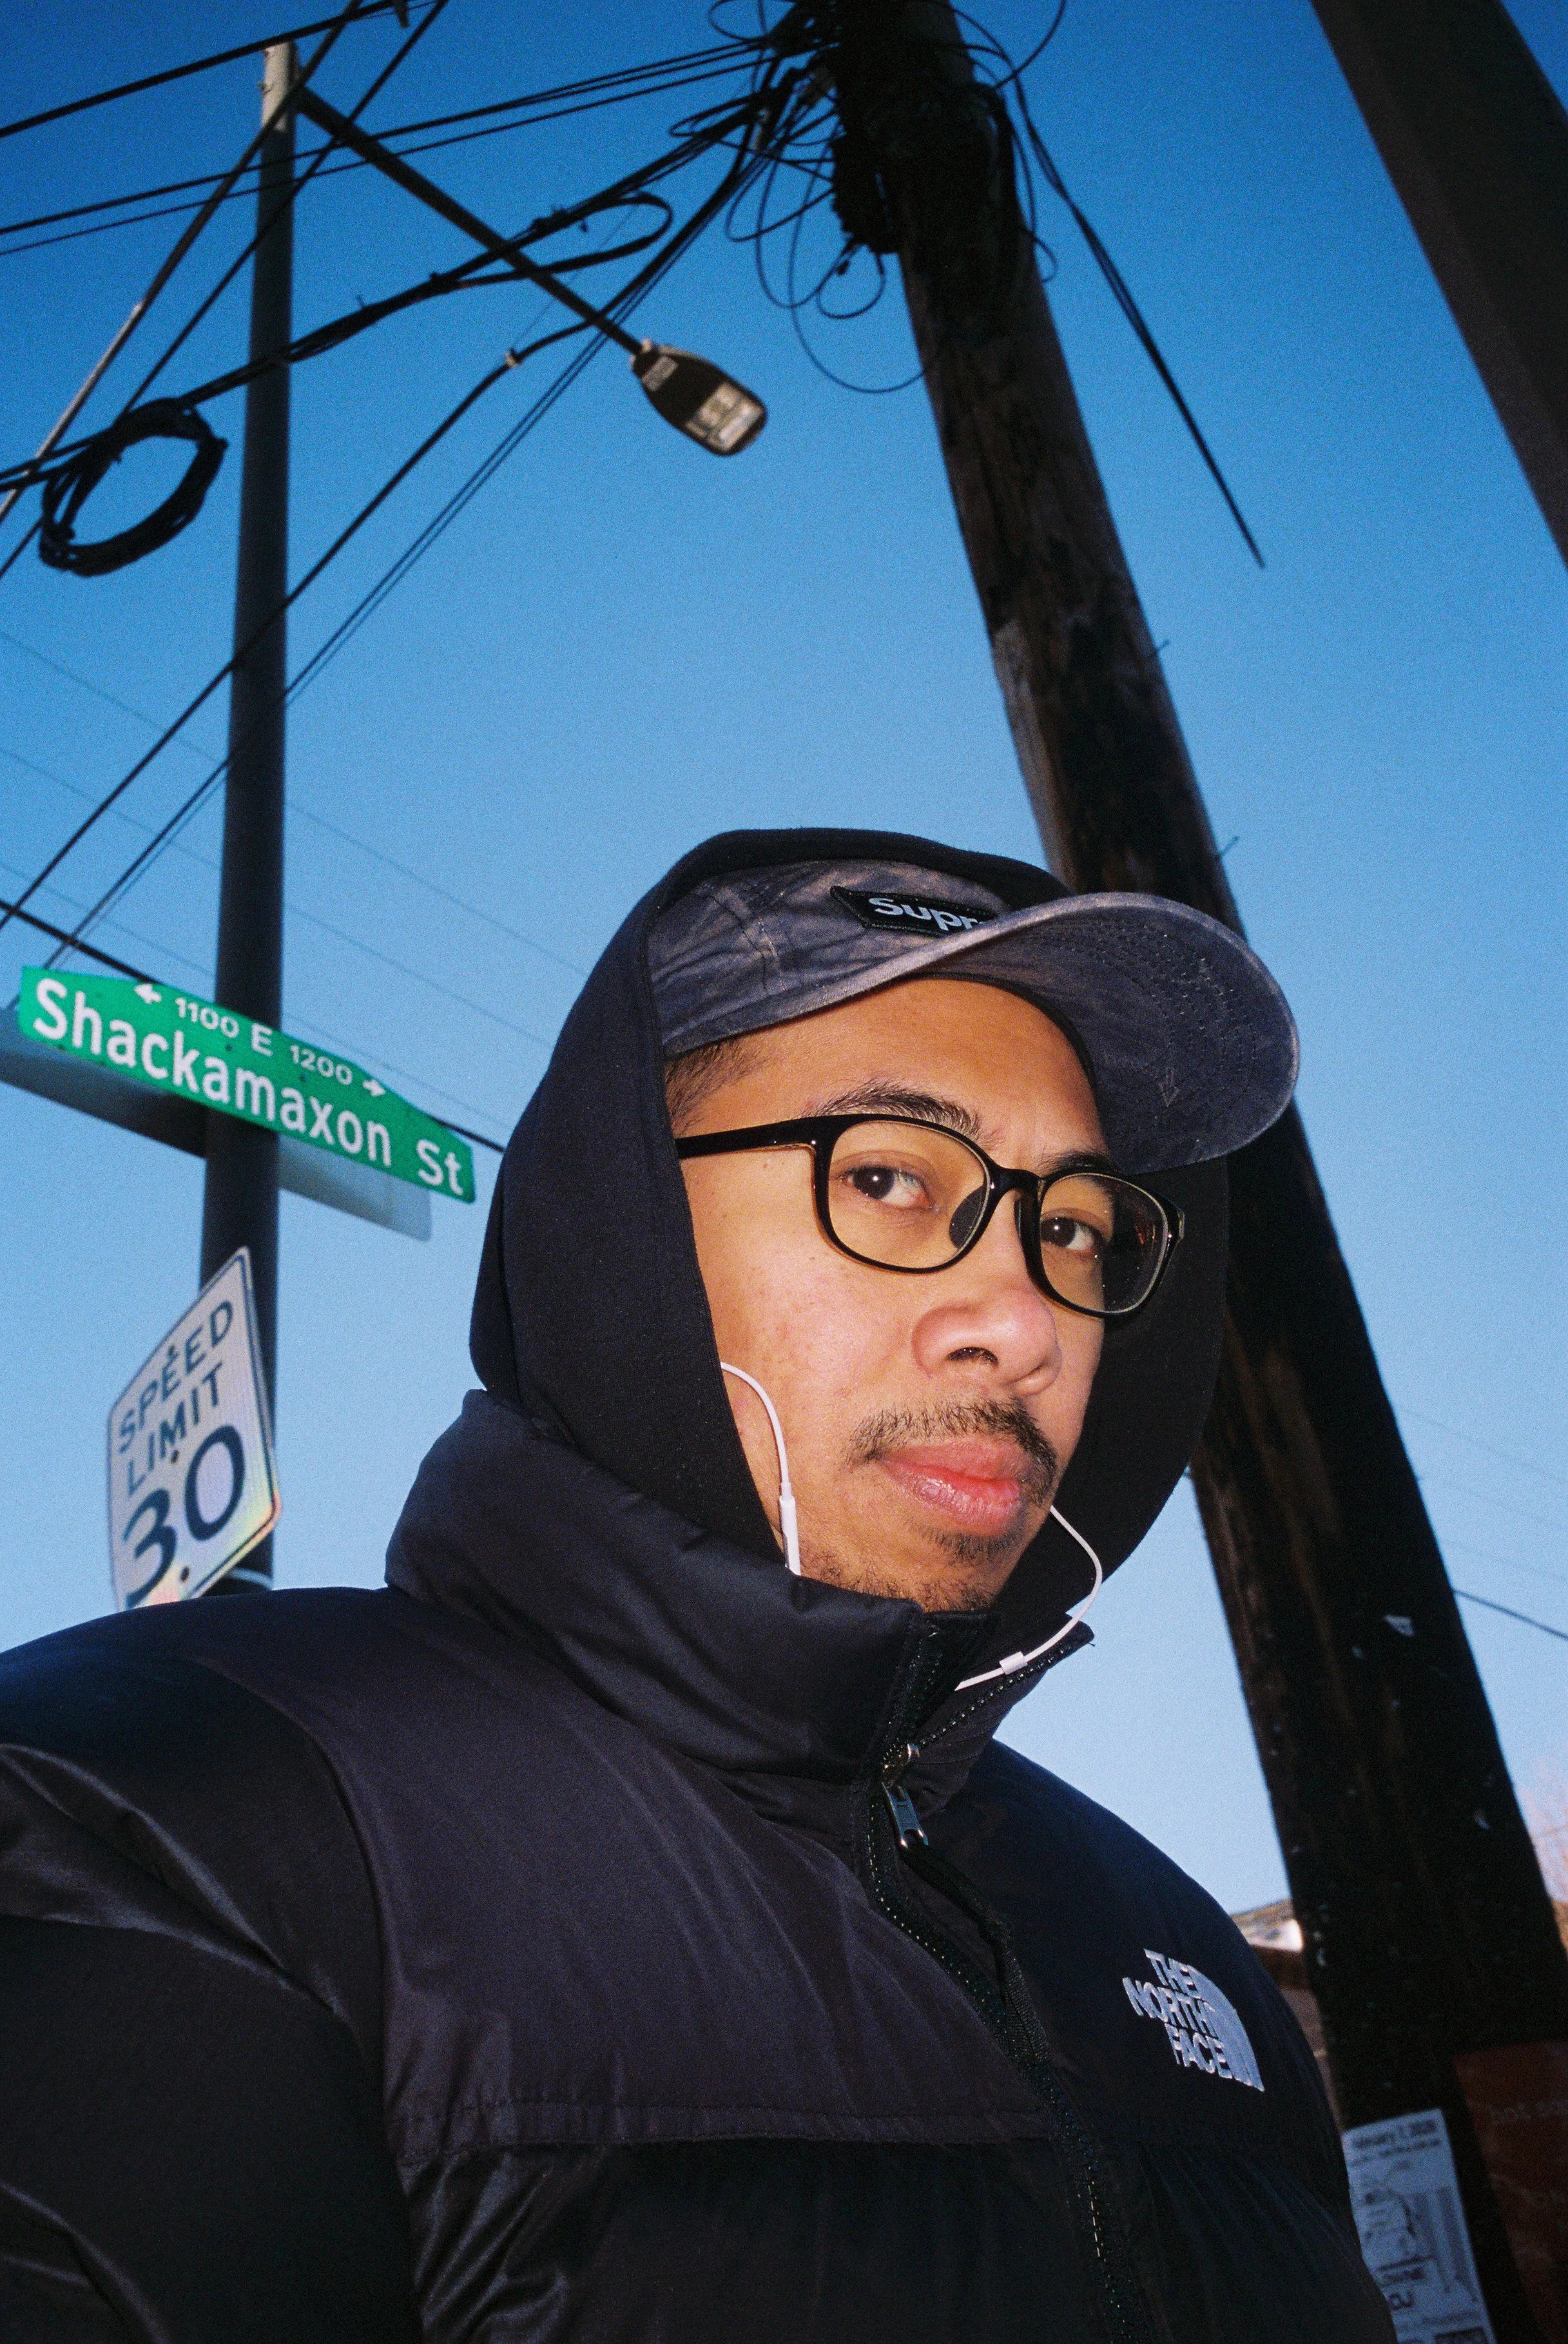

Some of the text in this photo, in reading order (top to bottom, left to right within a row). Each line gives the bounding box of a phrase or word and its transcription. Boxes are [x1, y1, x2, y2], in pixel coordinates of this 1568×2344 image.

[869, 897, 991, 931] Supr
[175, 996, 354, 1086] 1100 E 1200
[33, 978, 464, 1195] Shackamaxon St
[119, 1301, 233, 1455] SPEED
[127, 1362, 224, 1496] LIMIT
[122, 1424, 246, 1610] 30
[1122, 1977, 1219, 2039] NORTH
[1143, 1948, 1201, 1999] THE
[1165, 2023, 1233, 2078] FACE
